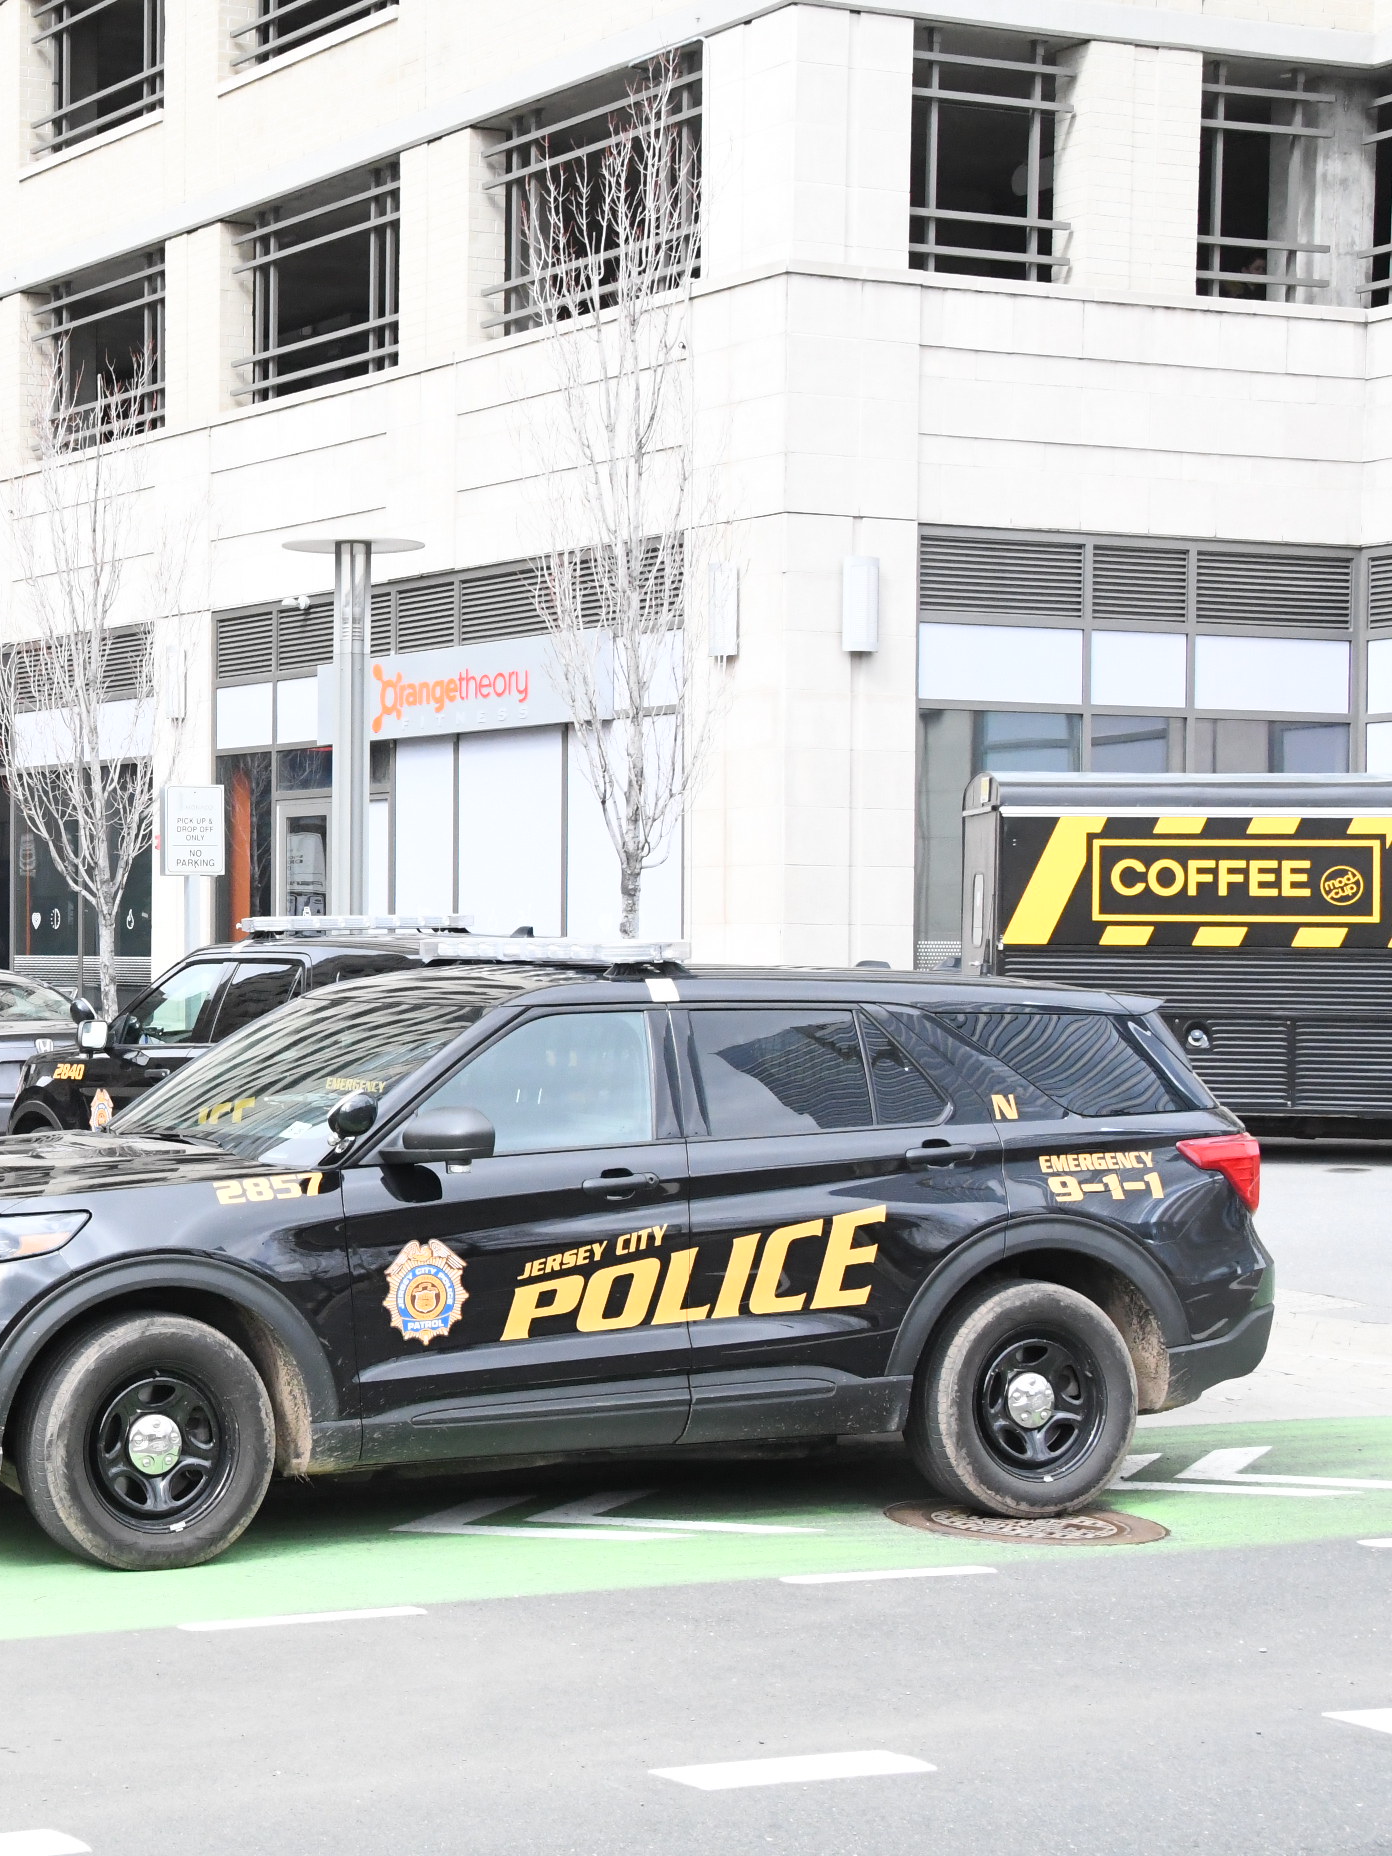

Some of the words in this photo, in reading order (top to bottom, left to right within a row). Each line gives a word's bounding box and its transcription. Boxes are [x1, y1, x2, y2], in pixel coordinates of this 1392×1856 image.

[176, 859, 215, 867] PARKING
[189, 849, 202, 857] NO
[1110, 858, 1312, 897] COFFEE
[1324, 871, 1355, 891] mod
[1331, 883, 1357, 899] cup
[52, 1063, 85, 1081] 2840
[325, 1076, 387, 1093] EMERGENCY
[990, 1093, 1019, 1120] N
[1038, 1151, 1154, 1174] EMERGENCY
[212, 1171, 323, 1205] 2857
[1047, 1171, 1165, 1202] 9-1-1
[516, 1239, 608, 1280] JERSEY
[615, 1223, 669, 1256] CITY
[499, 1204, 887, 1342] POLICE
[414, 1266, 438, 1275] CITY
[437, 1271, 454, 1305] POLICE
[407, 1319, 445, 1331] PATROL
